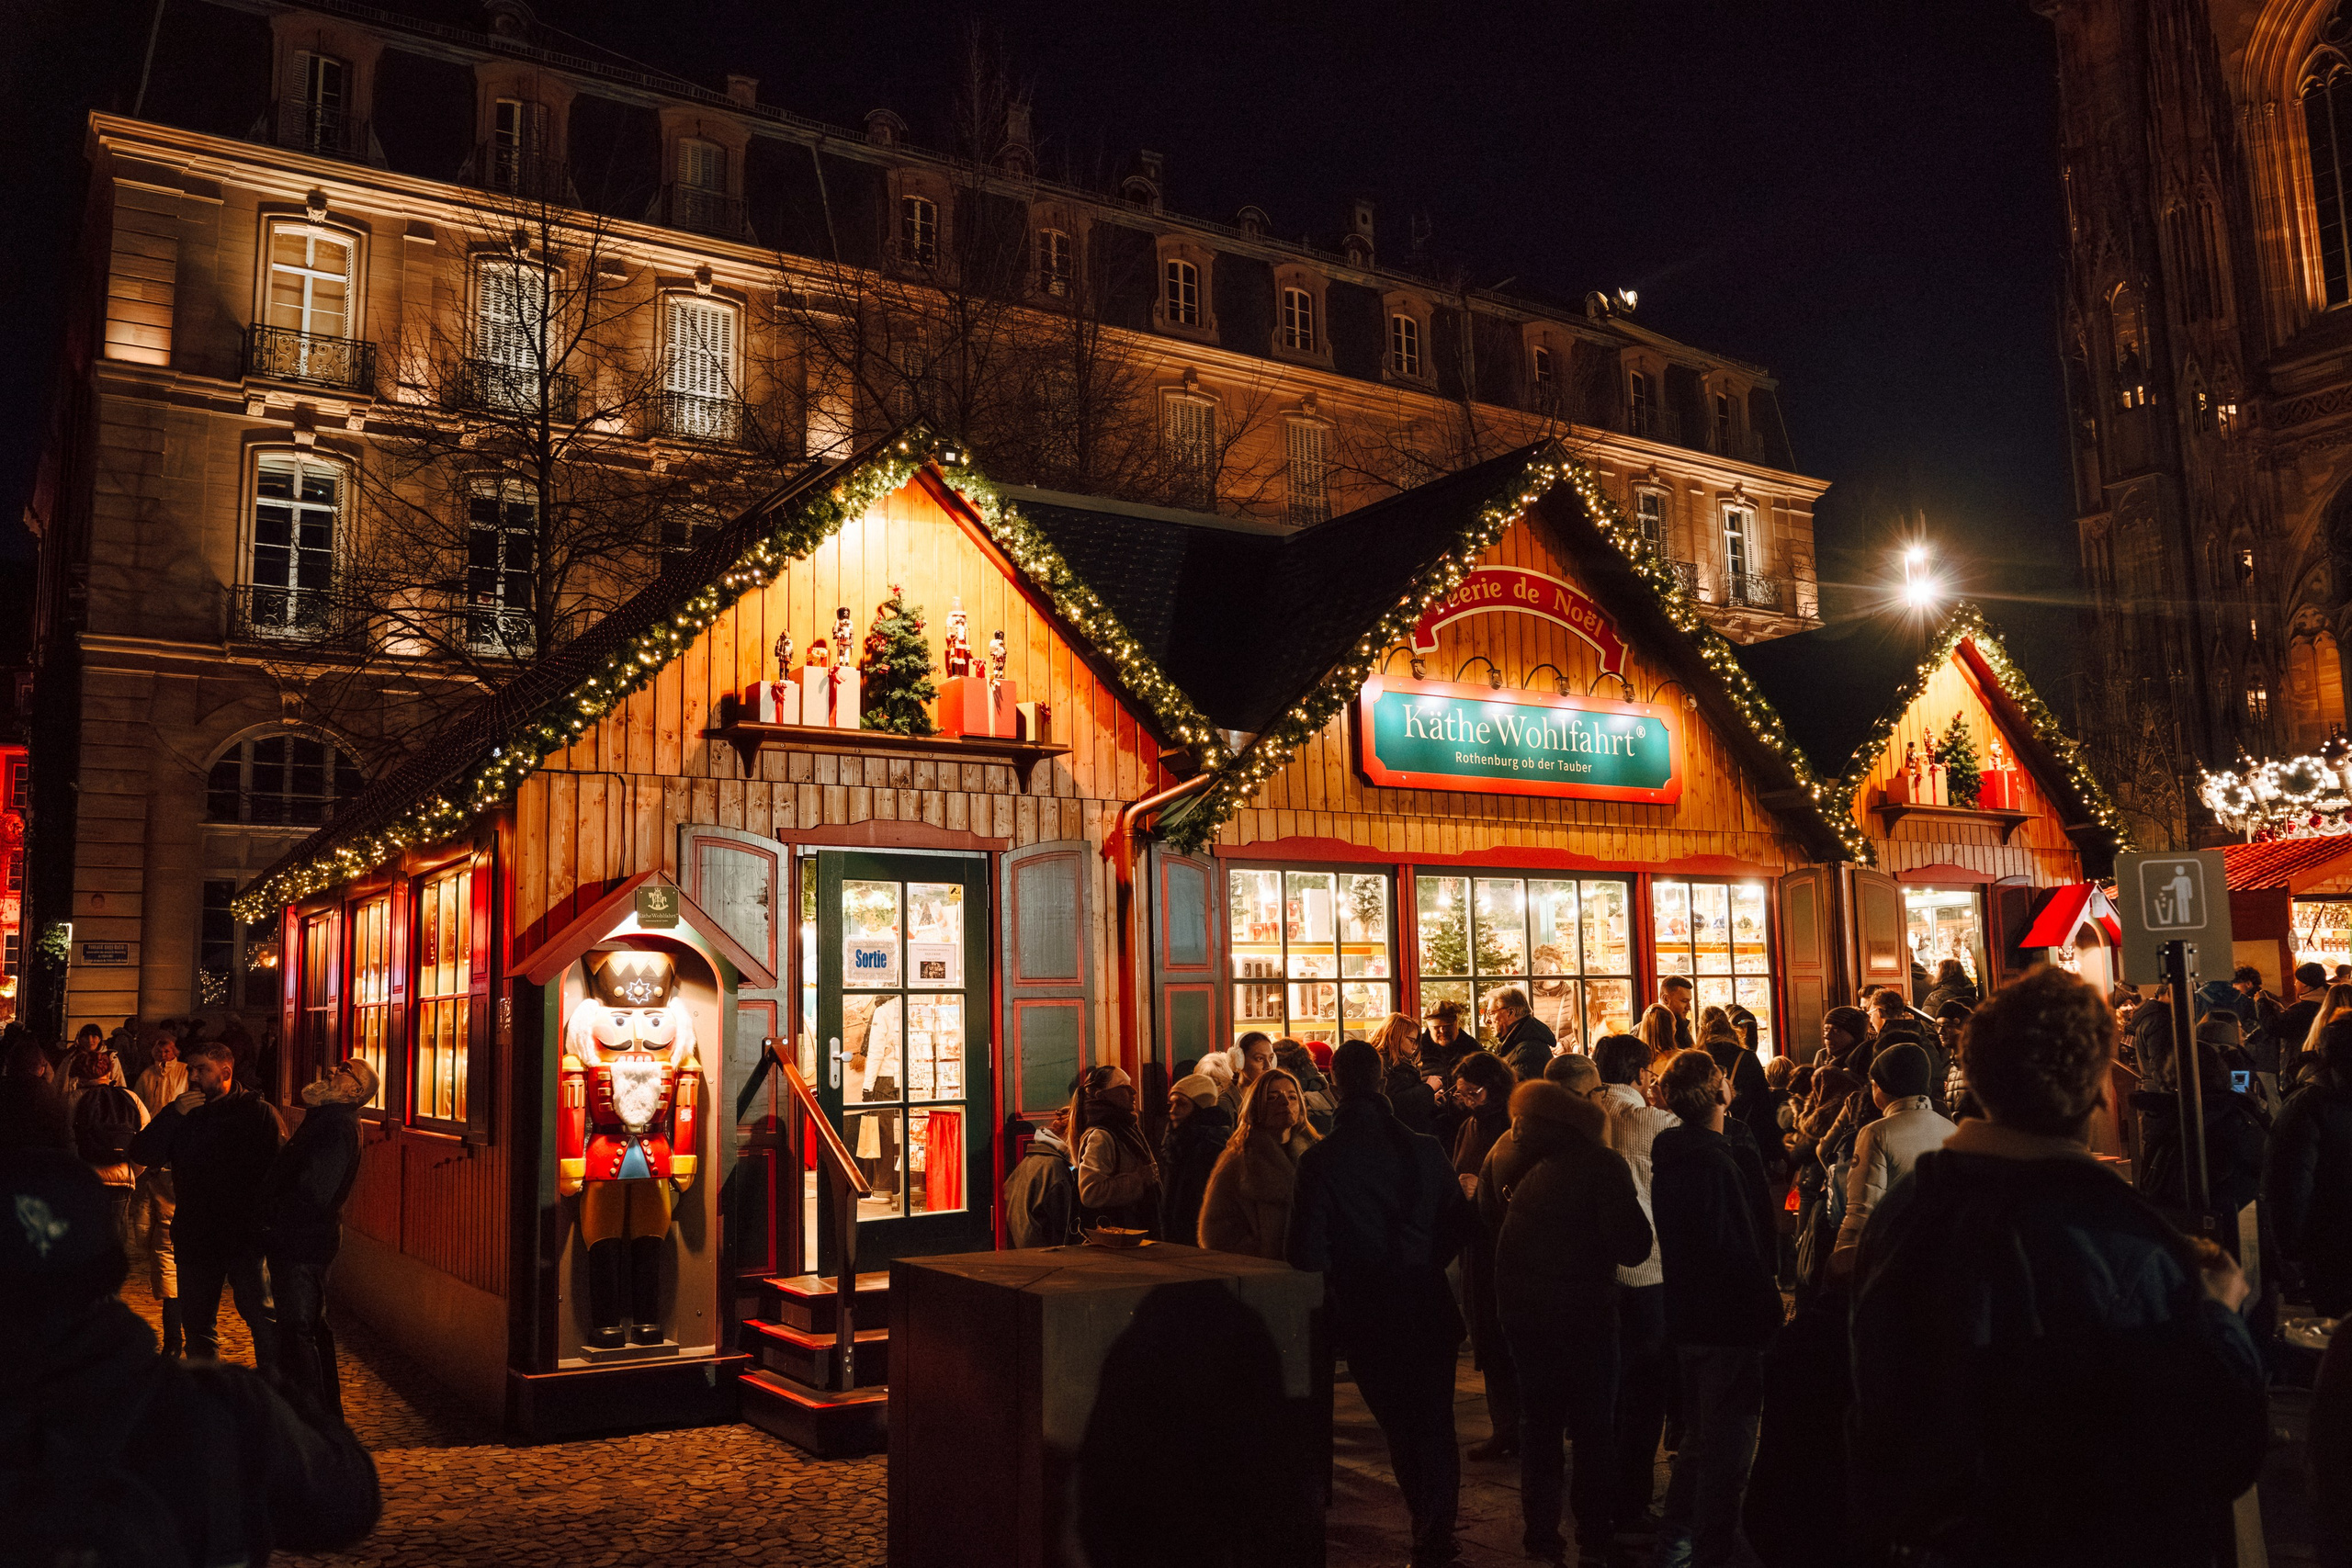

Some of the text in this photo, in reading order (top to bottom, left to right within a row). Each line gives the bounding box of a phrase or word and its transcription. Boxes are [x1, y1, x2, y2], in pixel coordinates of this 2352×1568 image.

[1513, 577, 1540, 604] de
[1553, 588, 1605, 637] Noël
[1403, 704, 1491, 745] Käthe
[1455, 751, 1593, 773] Rothenburg ob der Tauber
[855, 949, 888, 968] Sortie
